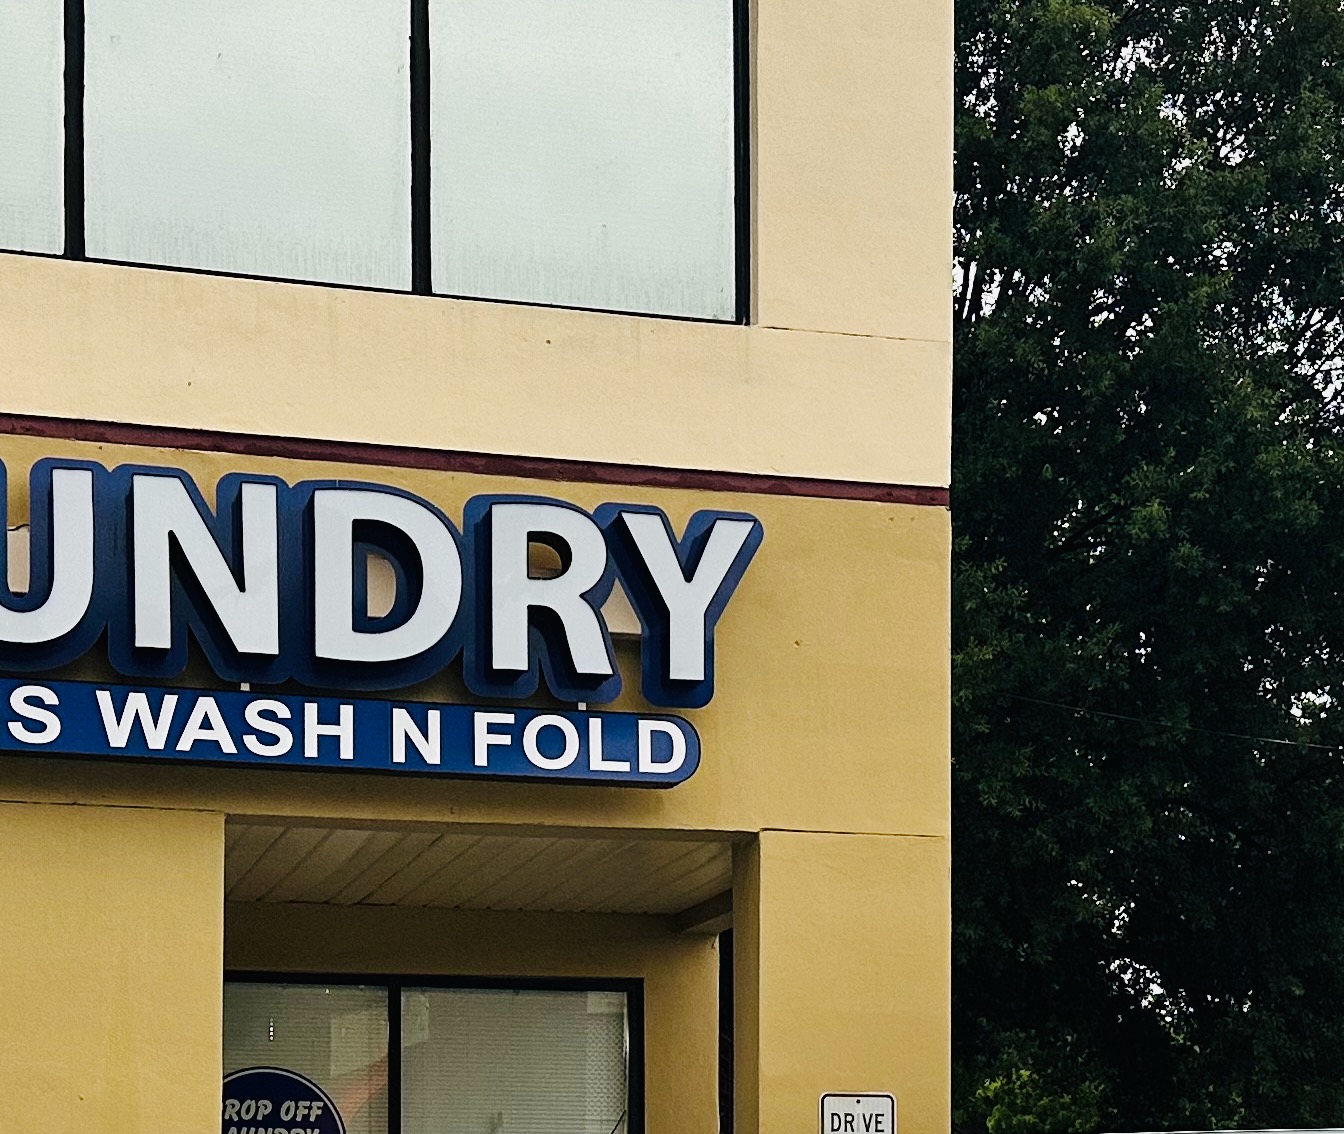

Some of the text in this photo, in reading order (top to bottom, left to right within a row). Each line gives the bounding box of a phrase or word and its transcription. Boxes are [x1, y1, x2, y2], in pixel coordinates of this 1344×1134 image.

[96, 688, 354, 760] WASH
[391, 707, 442, 766] N
[472, 711, 688, 775] FOLD
[223, 1099, 324, 1122] ROP OFF
[830, 1112, 885, 1133] DRIVE
